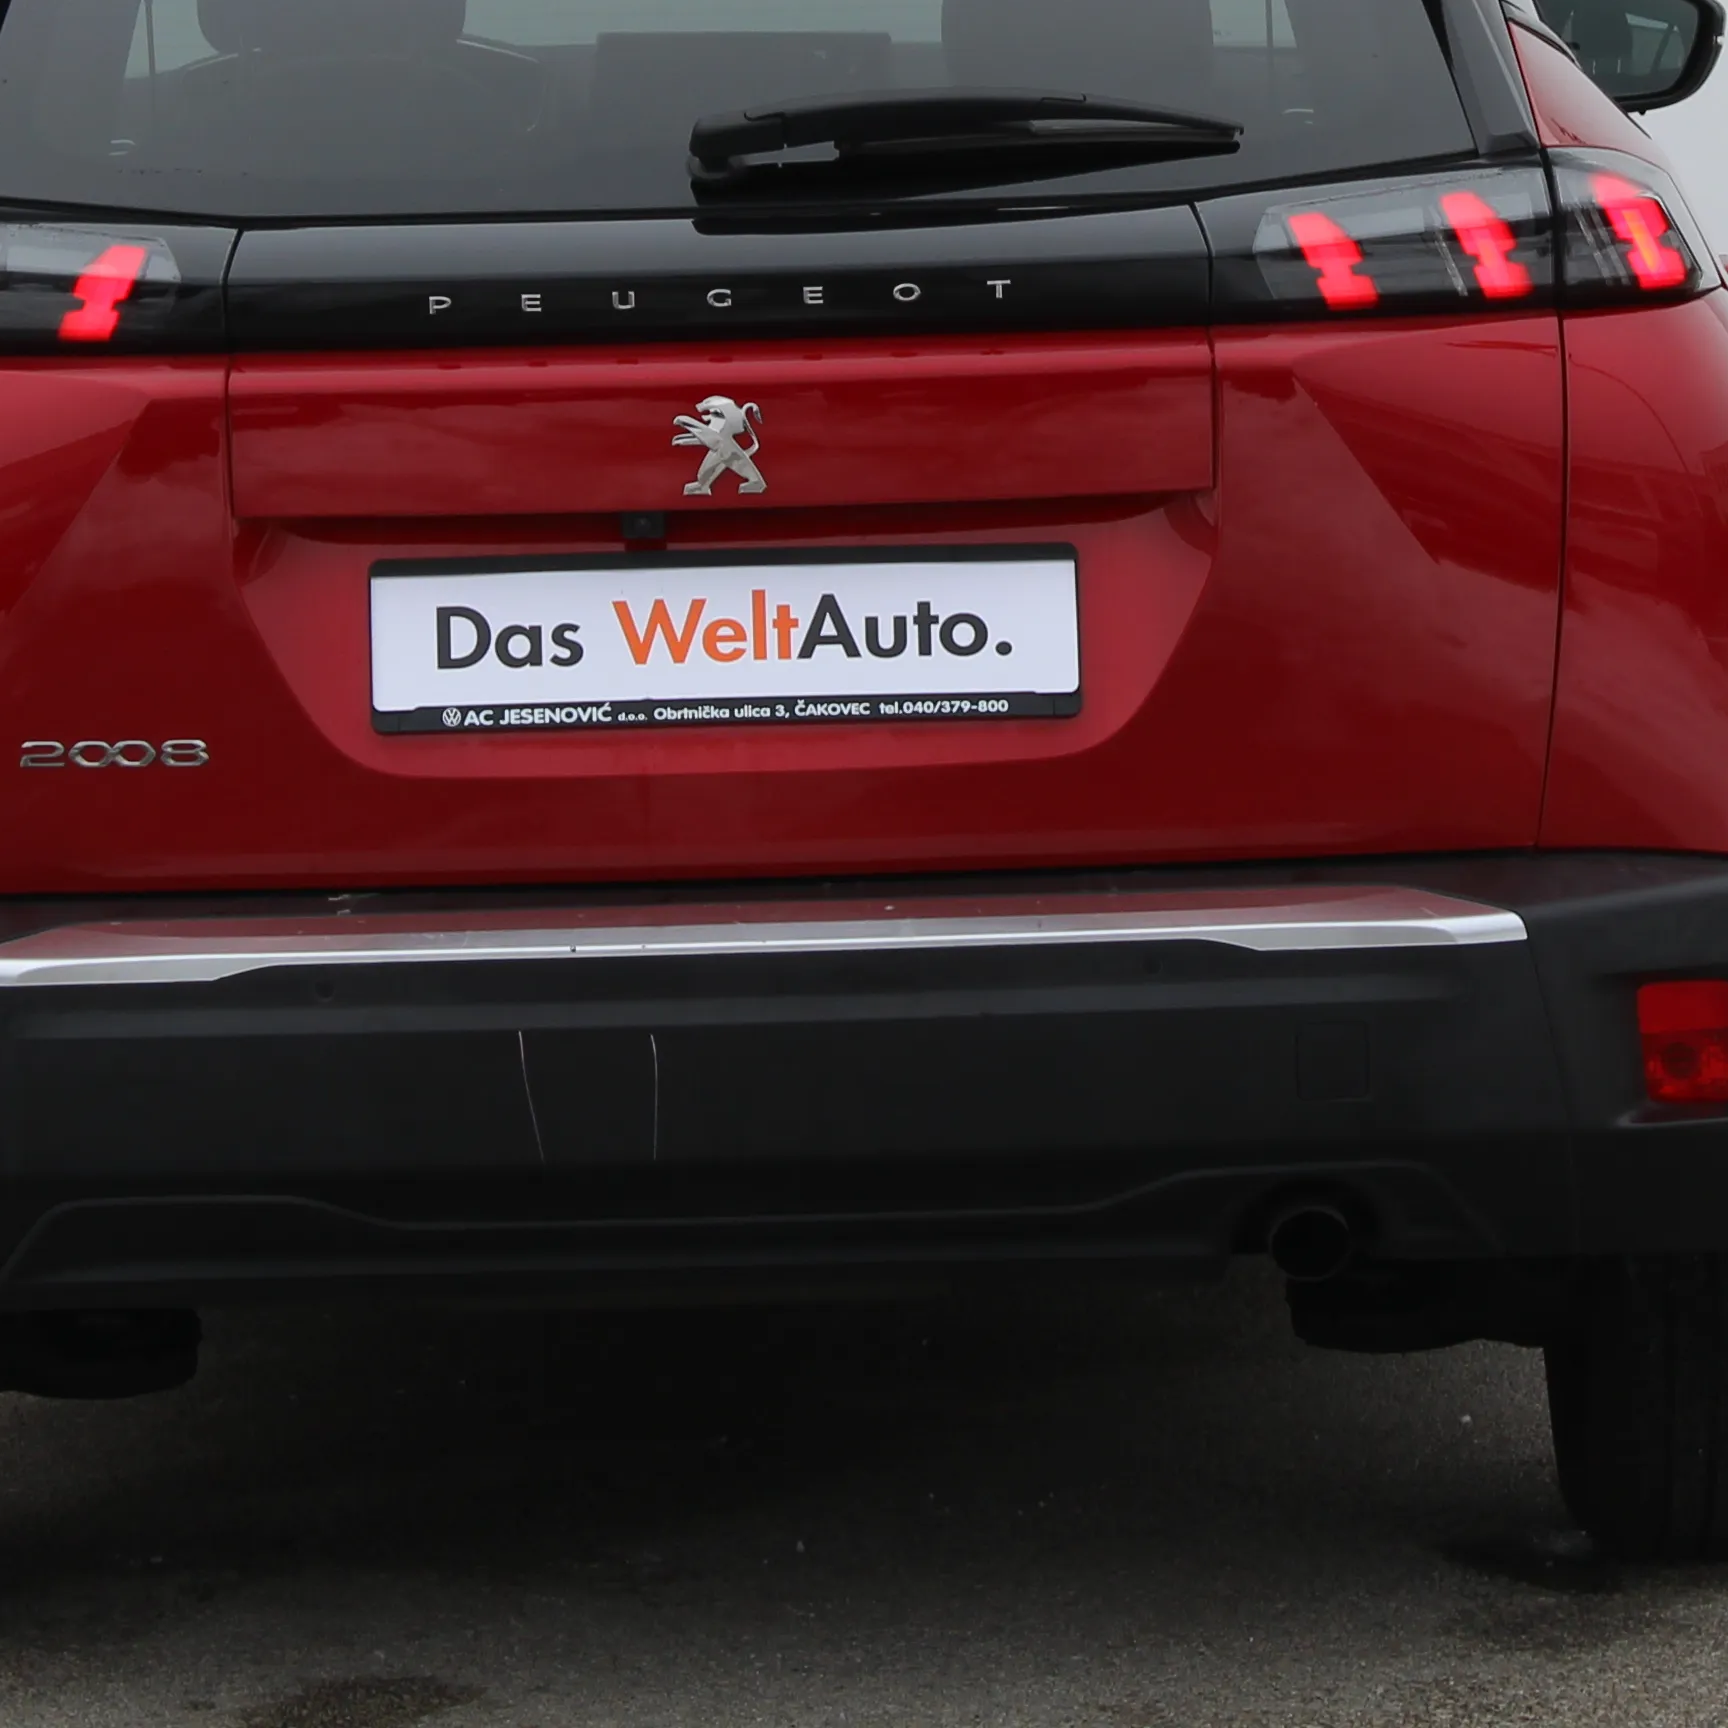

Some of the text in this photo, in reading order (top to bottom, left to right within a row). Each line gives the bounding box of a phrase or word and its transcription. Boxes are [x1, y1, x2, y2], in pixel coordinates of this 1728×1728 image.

[428, 279, 1012, 315] PEUGEOT
[437, 590, 1013, 670] Das WeltAuto.
[464, 699, 1009, 727] AC JESENOVIĆ d.o.o. Obrtnička ulica 3, ČAKOVEC tel.040/379-800
[20, 739, 210, 768] 2008
